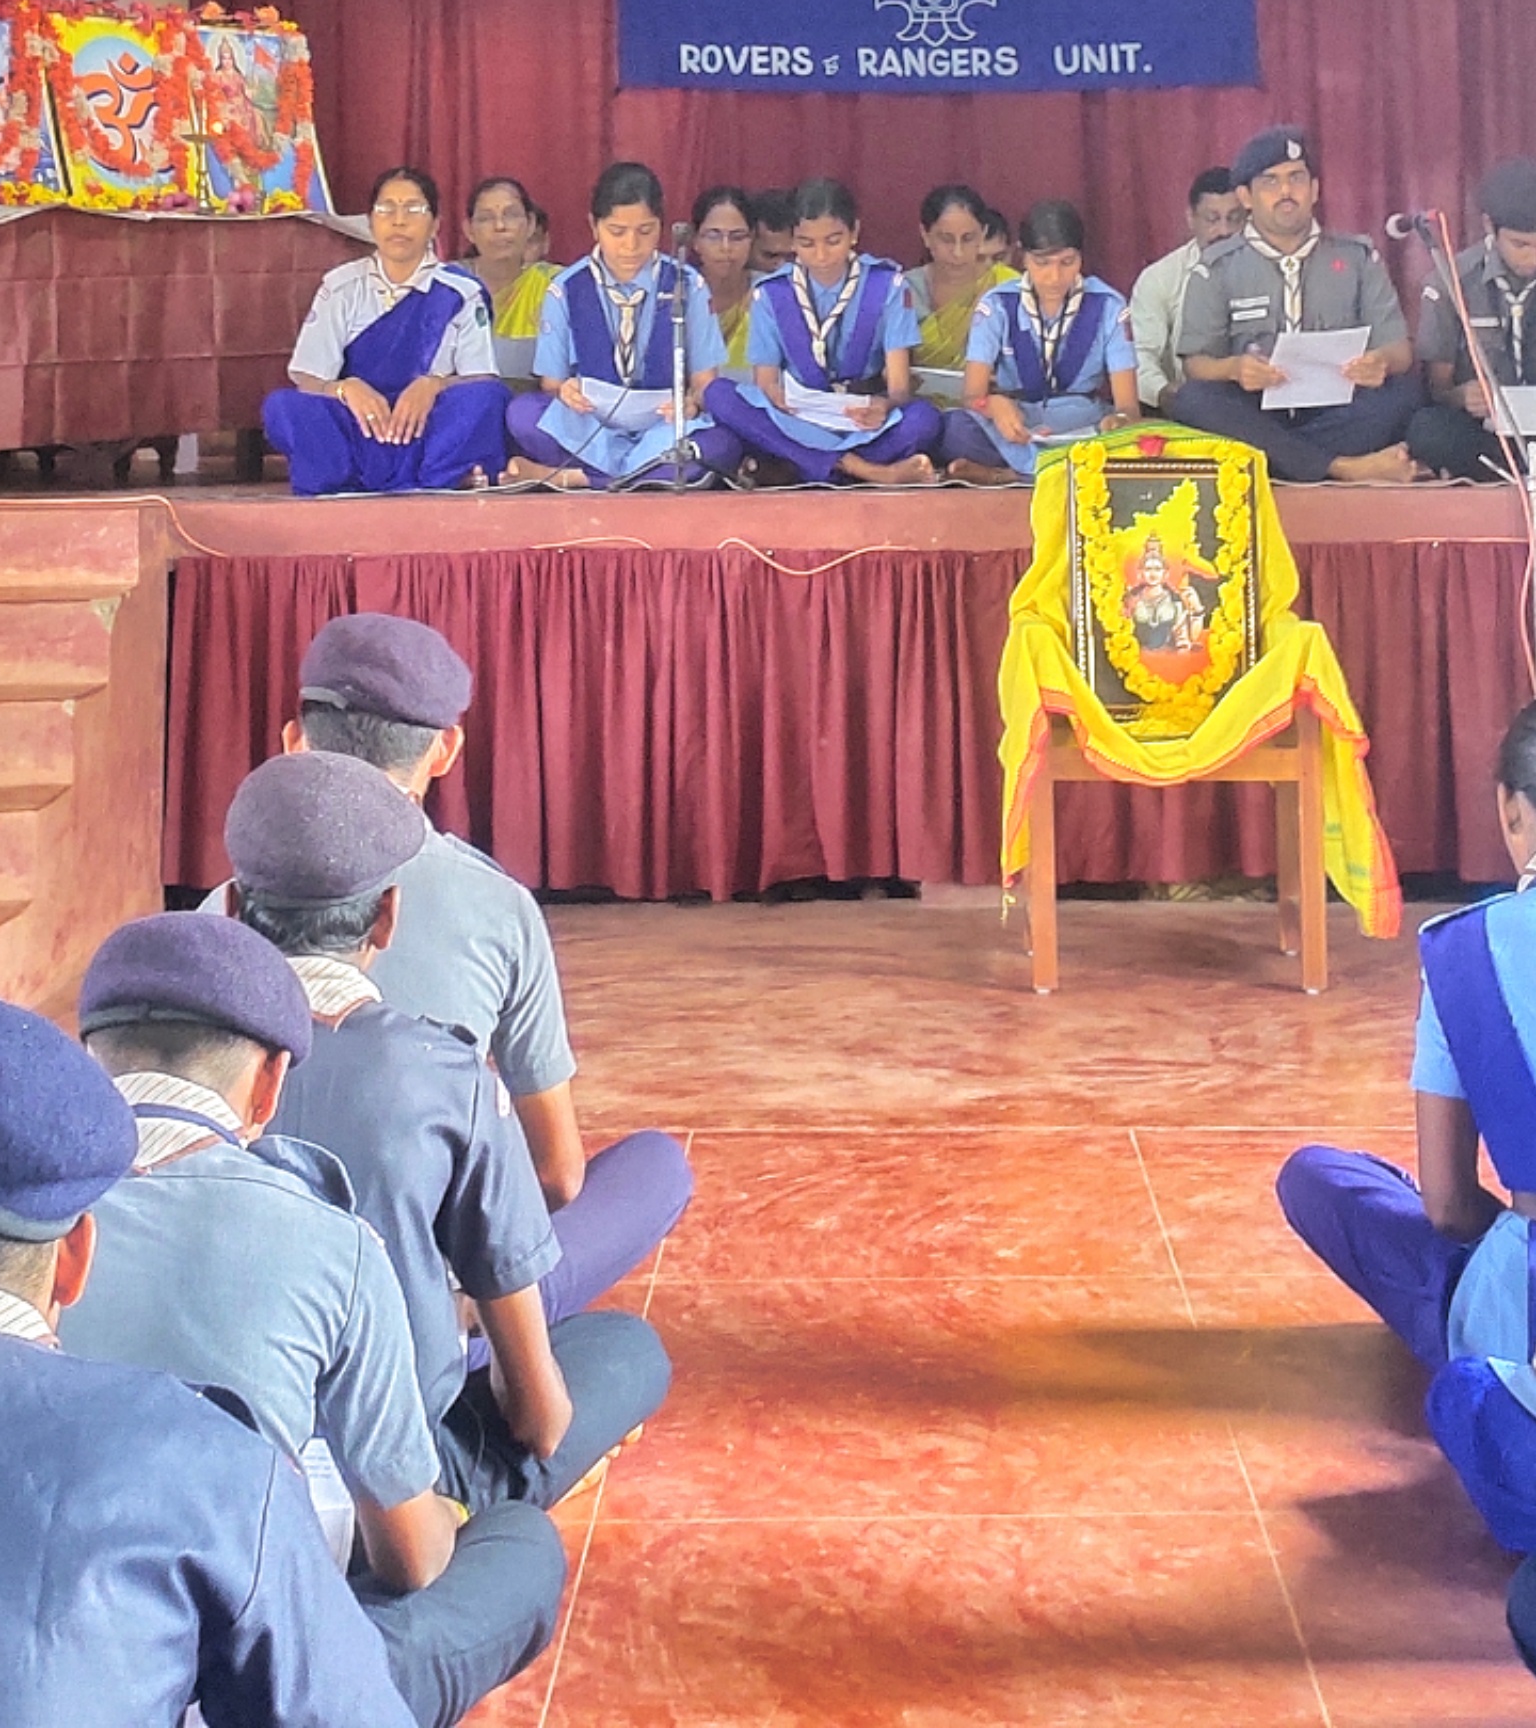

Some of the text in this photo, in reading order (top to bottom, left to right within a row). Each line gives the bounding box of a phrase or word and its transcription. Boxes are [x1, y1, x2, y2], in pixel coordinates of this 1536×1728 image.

[681, 44, 813, 75] ROVERS
[858, 47, 1018, 77] RANGERS
[1055, 43, 1152, 74] UNIT.
